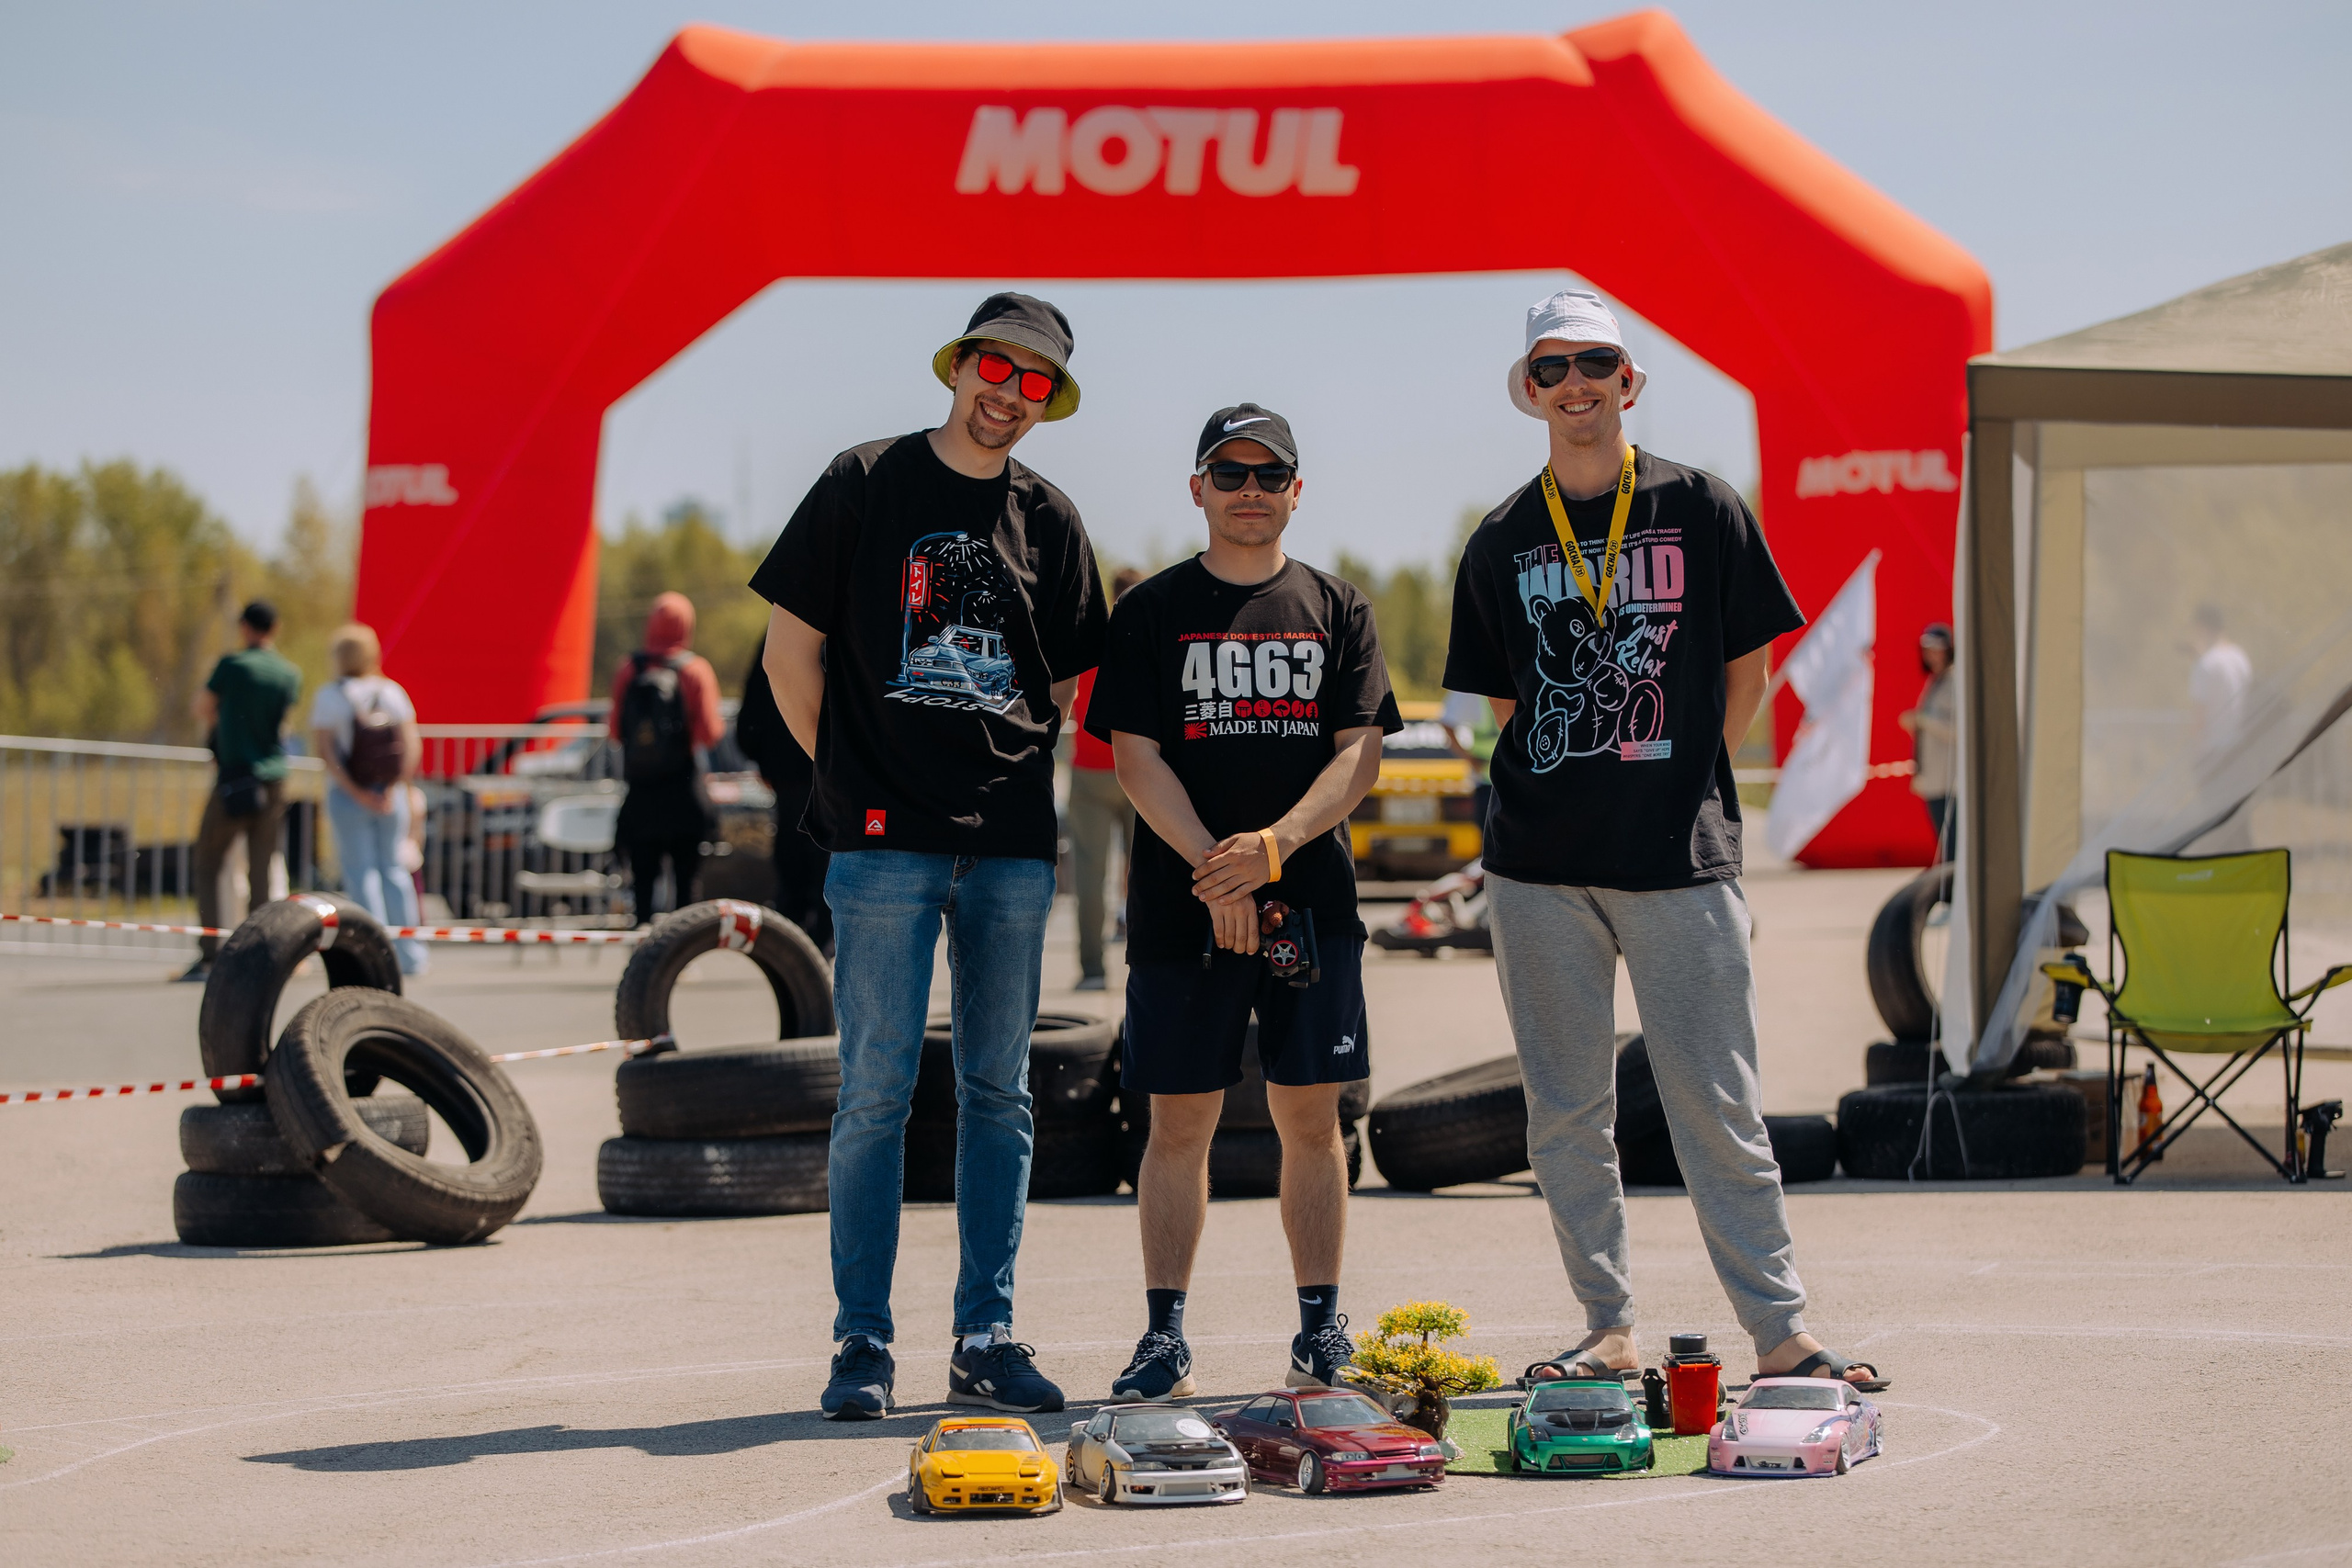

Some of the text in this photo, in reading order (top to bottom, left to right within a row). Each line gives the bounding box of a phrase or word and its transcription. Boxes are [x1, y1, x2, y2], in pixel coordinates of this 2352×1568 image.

[955, 104, 1362, 197] MOTUL
[1794, 448, 1960, 500] MOTUL
[1514, 544, 1559, 576] THE
[910, 566, 922, 603] トイレ
[1518, 545, 1685, 624] WORLD
[1625, 602, 1682, 614] UNDETERMINED
[1178, 631, 1325, 641] JAPANESE DOMESTIC MARKET
[1626, 615, 1679, 652] Just
[1182, 641, 1325, 700] 4G63
[1615, 640, 1667, 678] Relax
[1209, 720, 1319, 738] MADE IN JAPAN
[1333, 1044, 1351, 1055] PUMA
